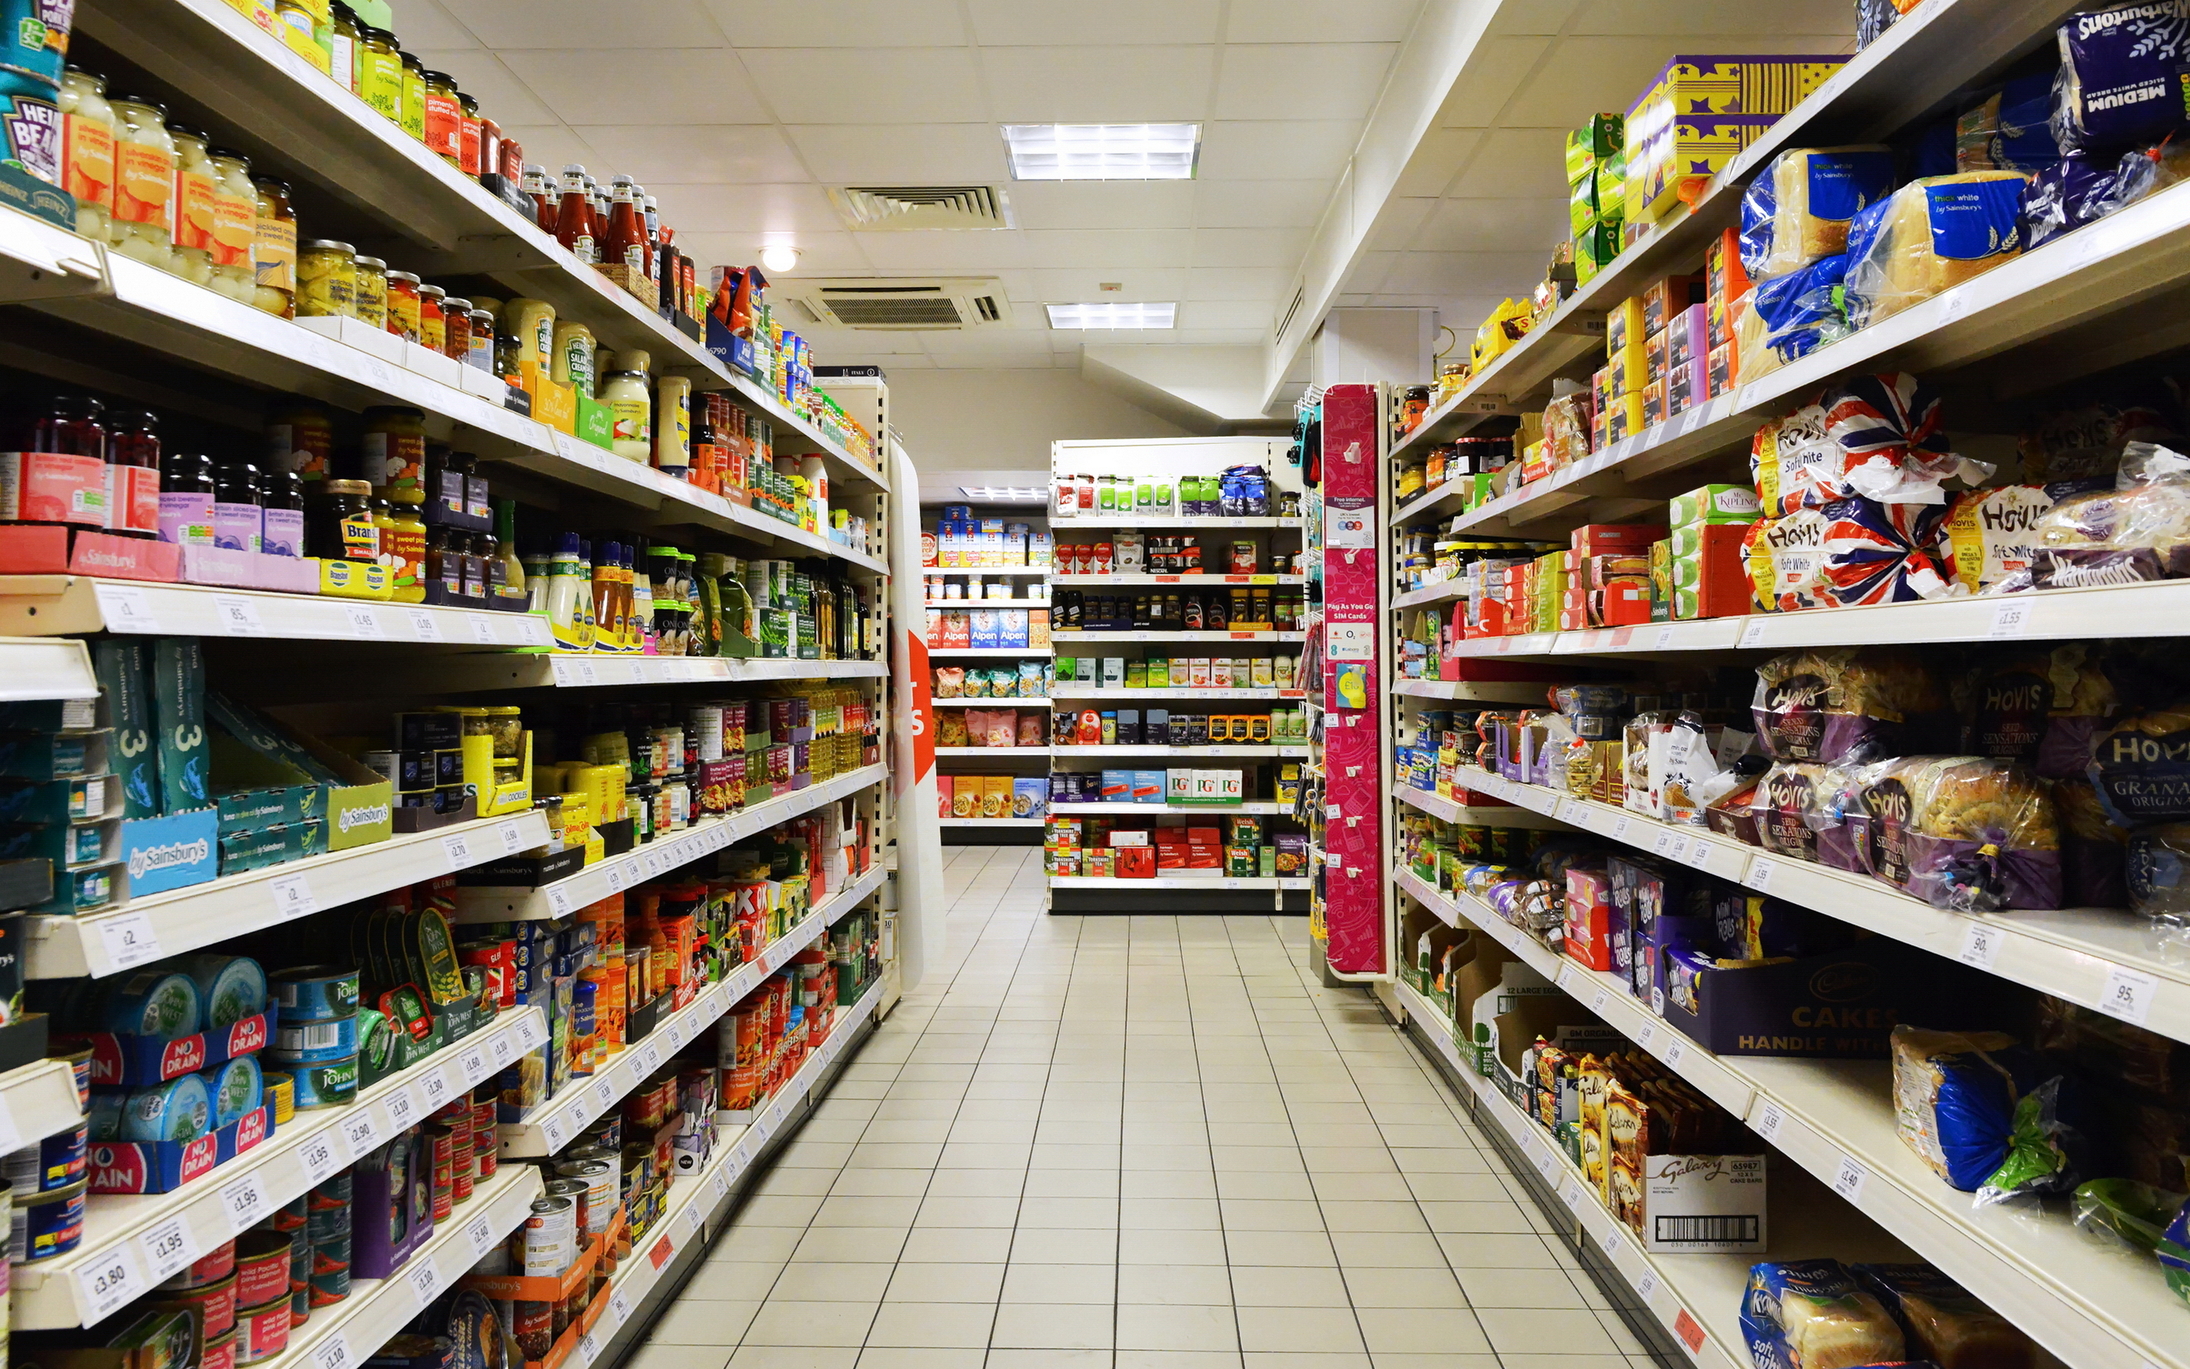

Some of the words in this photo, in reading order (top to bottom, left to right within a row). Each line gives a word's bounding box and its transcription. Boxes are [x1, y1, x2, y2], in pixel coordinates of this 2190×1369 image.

[2113, 83, 2137, 92] WHITE
[2139, 77, 2165, 87] SLICED
[2086, 88, 2111, 99] BREAD
[2088, 84, 2166, 113] MEDIUM
[428, 98, 454, 110] pimento
[37, 195, 66, 217] HEINZ
[1956, 194, 1979, 202] white
[1935, 204, 1945, 214] by
[1945, 204, 1982, 212] Sainsbury's
[397, 545, 405, 553] by
[87, 549, 136, 570] Sainsbury's
[199, 557, 245, 575] Sainsbury's
[1999, 612, 2021, 625] £1.55
[944, 631, 969, 641] Alpen
[972, 631, 997, 641] Alpen
[1000, 631, 1026, 641] Alpen
[119, 662, 129, 721] Sainsbury's
[176, 661, 184, 717] Sainsbury's
[1985, 685, 2042, 711] HOVIS
[120, 729, 148, 758] 3
[175, 724, 202, 752] 3
[508, 790, 528, 802] COCKLES
[1771, 783, 1812, 808] HOVIS
[1865, 791, 1906, 823] HOVIS
[339, 811, 351, 831] by
[350, 806, 388, 826] Sainsbury's
[131, 855, 145, 874] by
[145, 843, 207, 868] Sainsbury's
[123, 930, 136, 946] £2
[1543, 986, 1562, 994] EGGS
[2117, 985, 2134, 1004] 95p
[1792, 1005, 1898, 1027] CAKES
[240, 1021, 256, 1036] NO
[174, 1040, 193, 1055] NO
[233, 1032, 262, 1052] DRAIN
[1738, 1035, 1825, 1051] HANDLE
[166, 1053, 200, 1074] DRAIN
[466, 1057, 480, 1071] £1.60
[322, 1072, 351, 1089] JOHN
[428, 1081, 443, 1097] £1.30
[393, 1101, 409, 1117] £1.10
[246, 1113, 258, 1127] NO
[240, 1126, 263, 1146] DRAIN
[351, 1123, 370, 1143] £2.90
[192, 1139, 207, 1155] NO
[185, 1153, 213, 1176] DRAIN
[308, 1149, 328, 1167] £1.95
[1647, 1158, 1730, 1184] Galaxy
[1841, 1169, 1858, 1187] £1.40
[235, 1187, 258, 1211] £1.95
[156, 1232, 183, 1258] £1.95
[95, 1265, 125, 1295] £3.80
[524, 1317, 532, 1327] by
[1752, 1339, 1773, 1355] soft
